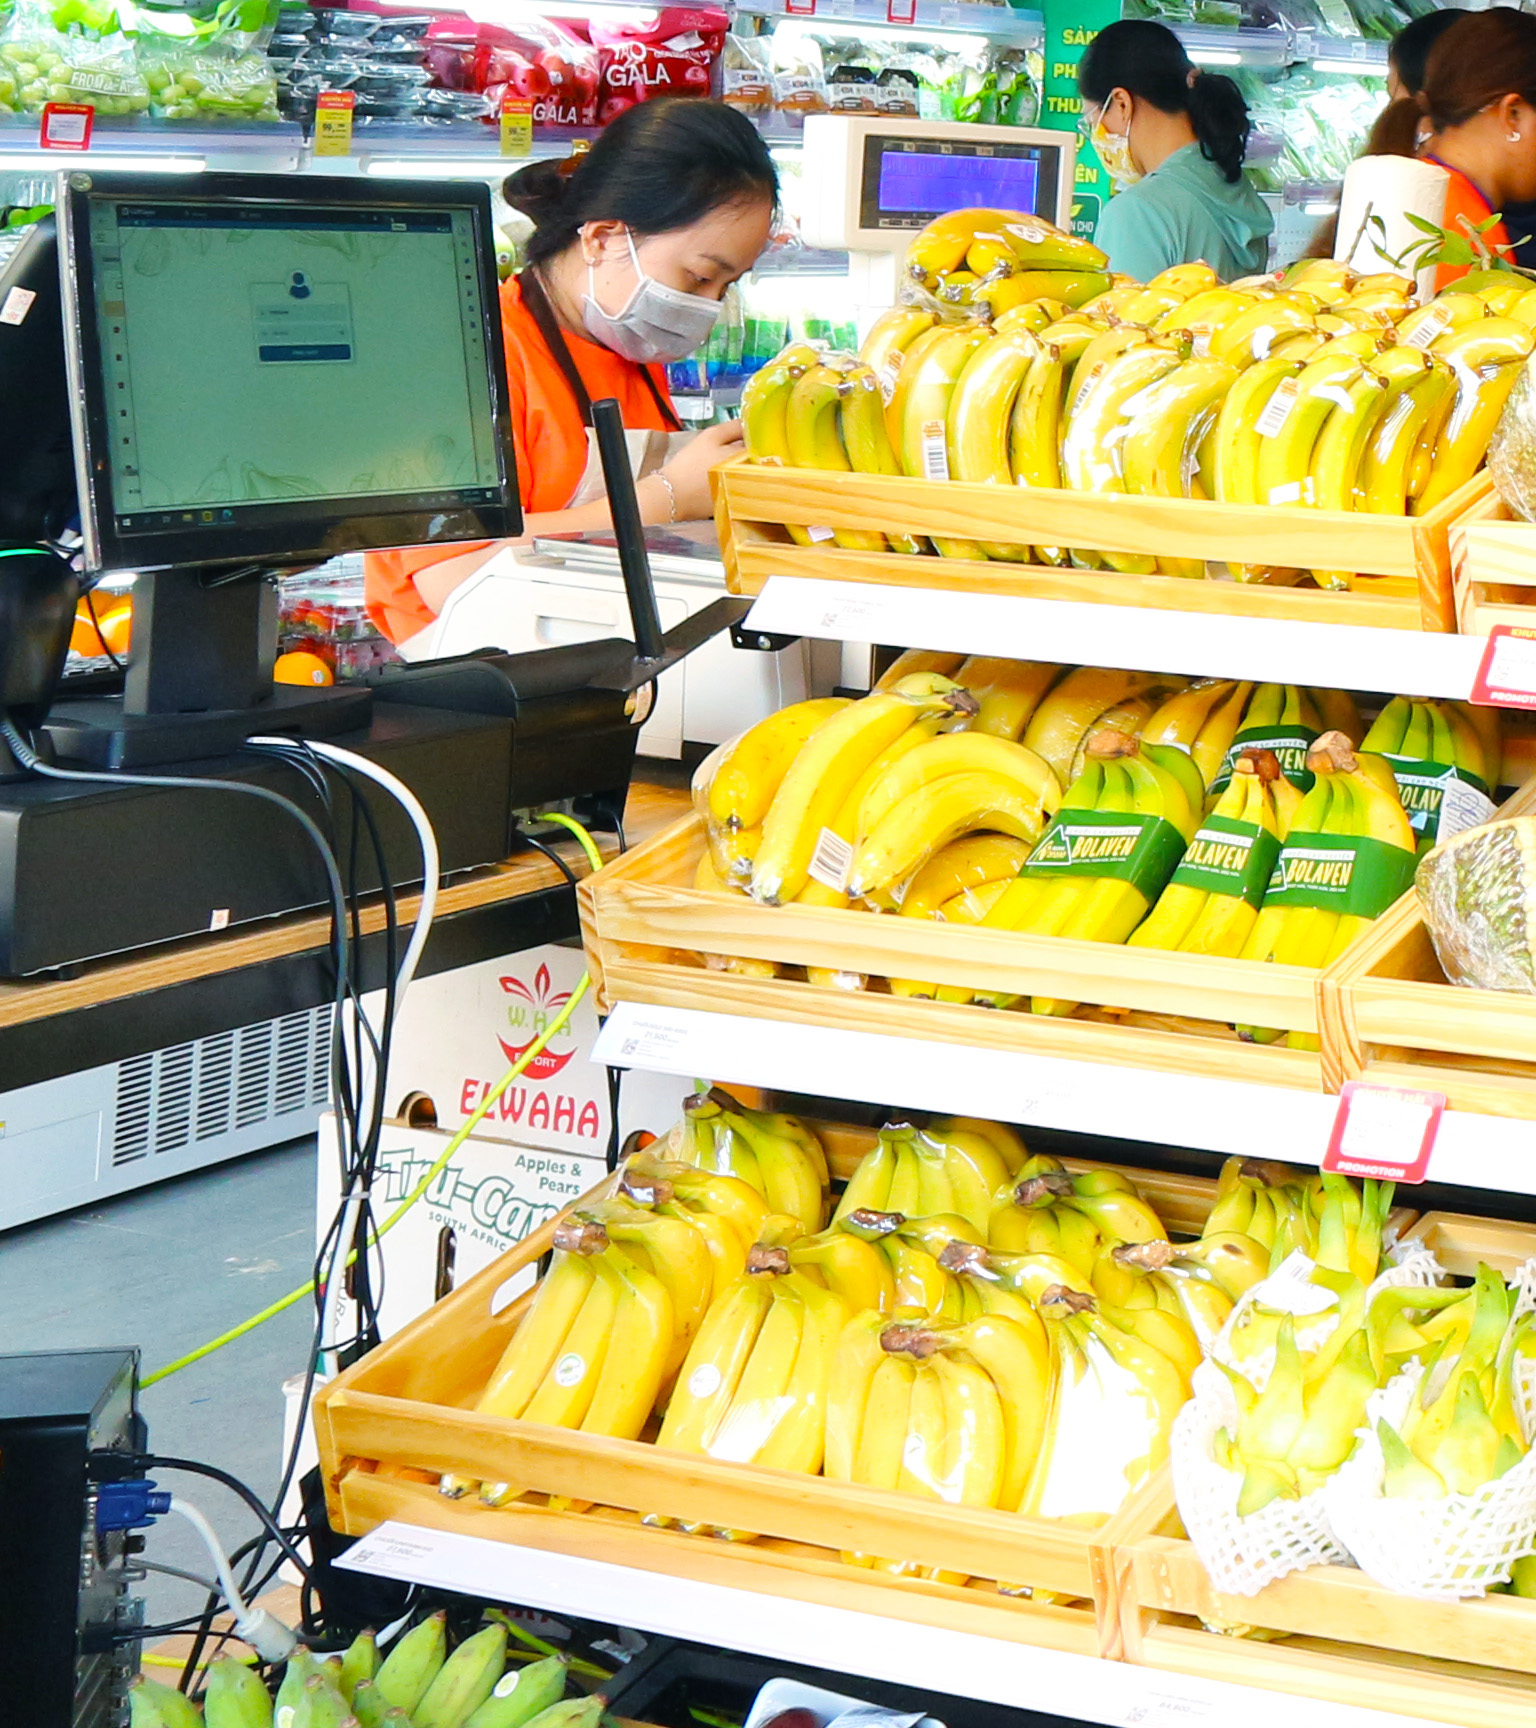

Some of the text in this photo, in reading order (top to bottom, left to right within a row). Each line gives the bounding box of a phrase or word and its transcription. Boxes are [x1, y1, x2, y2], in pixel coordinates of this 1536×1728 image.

[606, 63, 671, 87] GALA
[1054, 63, 1078, 79] PH
[533, 103, 577, 124] GALA
[1071, 836, 1137, 858] BOLAVEN
[1287, 858, 1353, 887] BOLAVEN
[459, 1078, 600, 1139] ELWAHA
[514, 1154, 582, 1177] Apples &
[1336, 1160, 1406, 1178] PROMOTION
[539, 1177, 580, 1195] Pears
[428, 1211, 467, 1234] SOUTH
